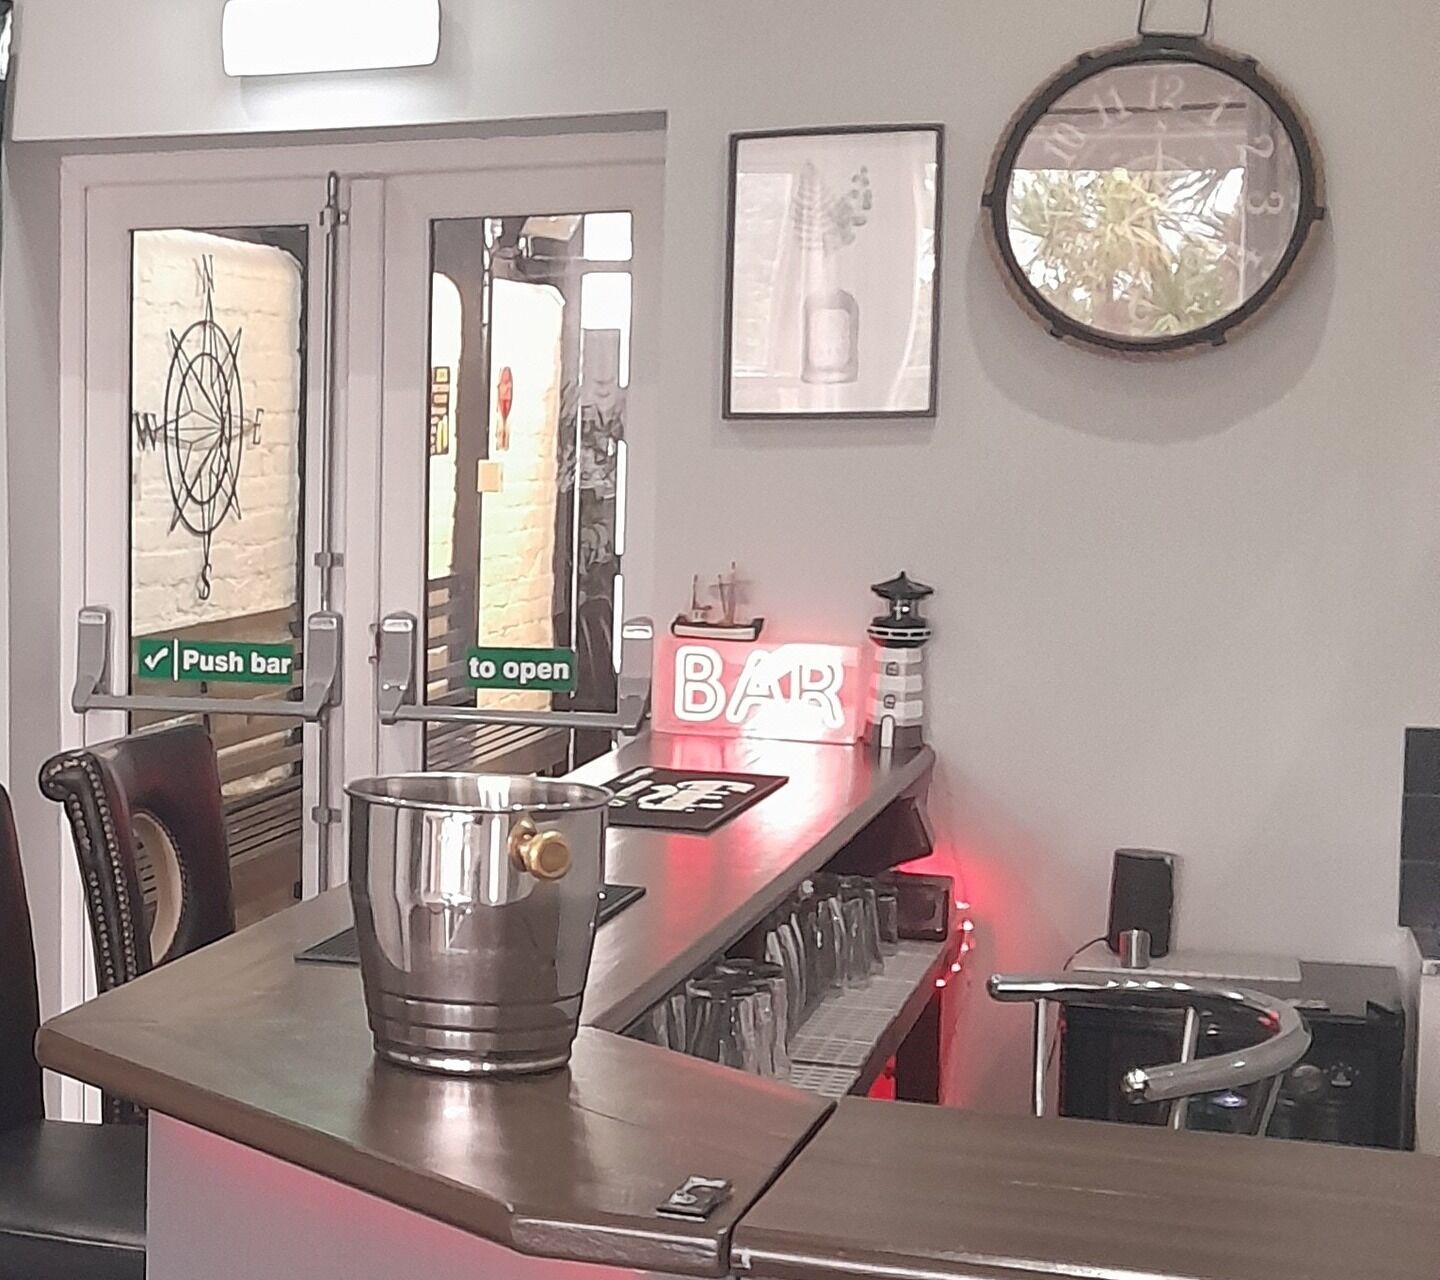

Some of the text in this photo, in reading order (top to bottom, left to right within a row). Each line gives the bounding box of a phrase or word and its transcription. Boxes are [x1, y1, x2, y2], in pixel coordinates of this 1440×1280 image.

[182, 650, 291, 675] Push bar
[469, 657, 570, 683] to open
[675, 646, 844, 727] BAR
